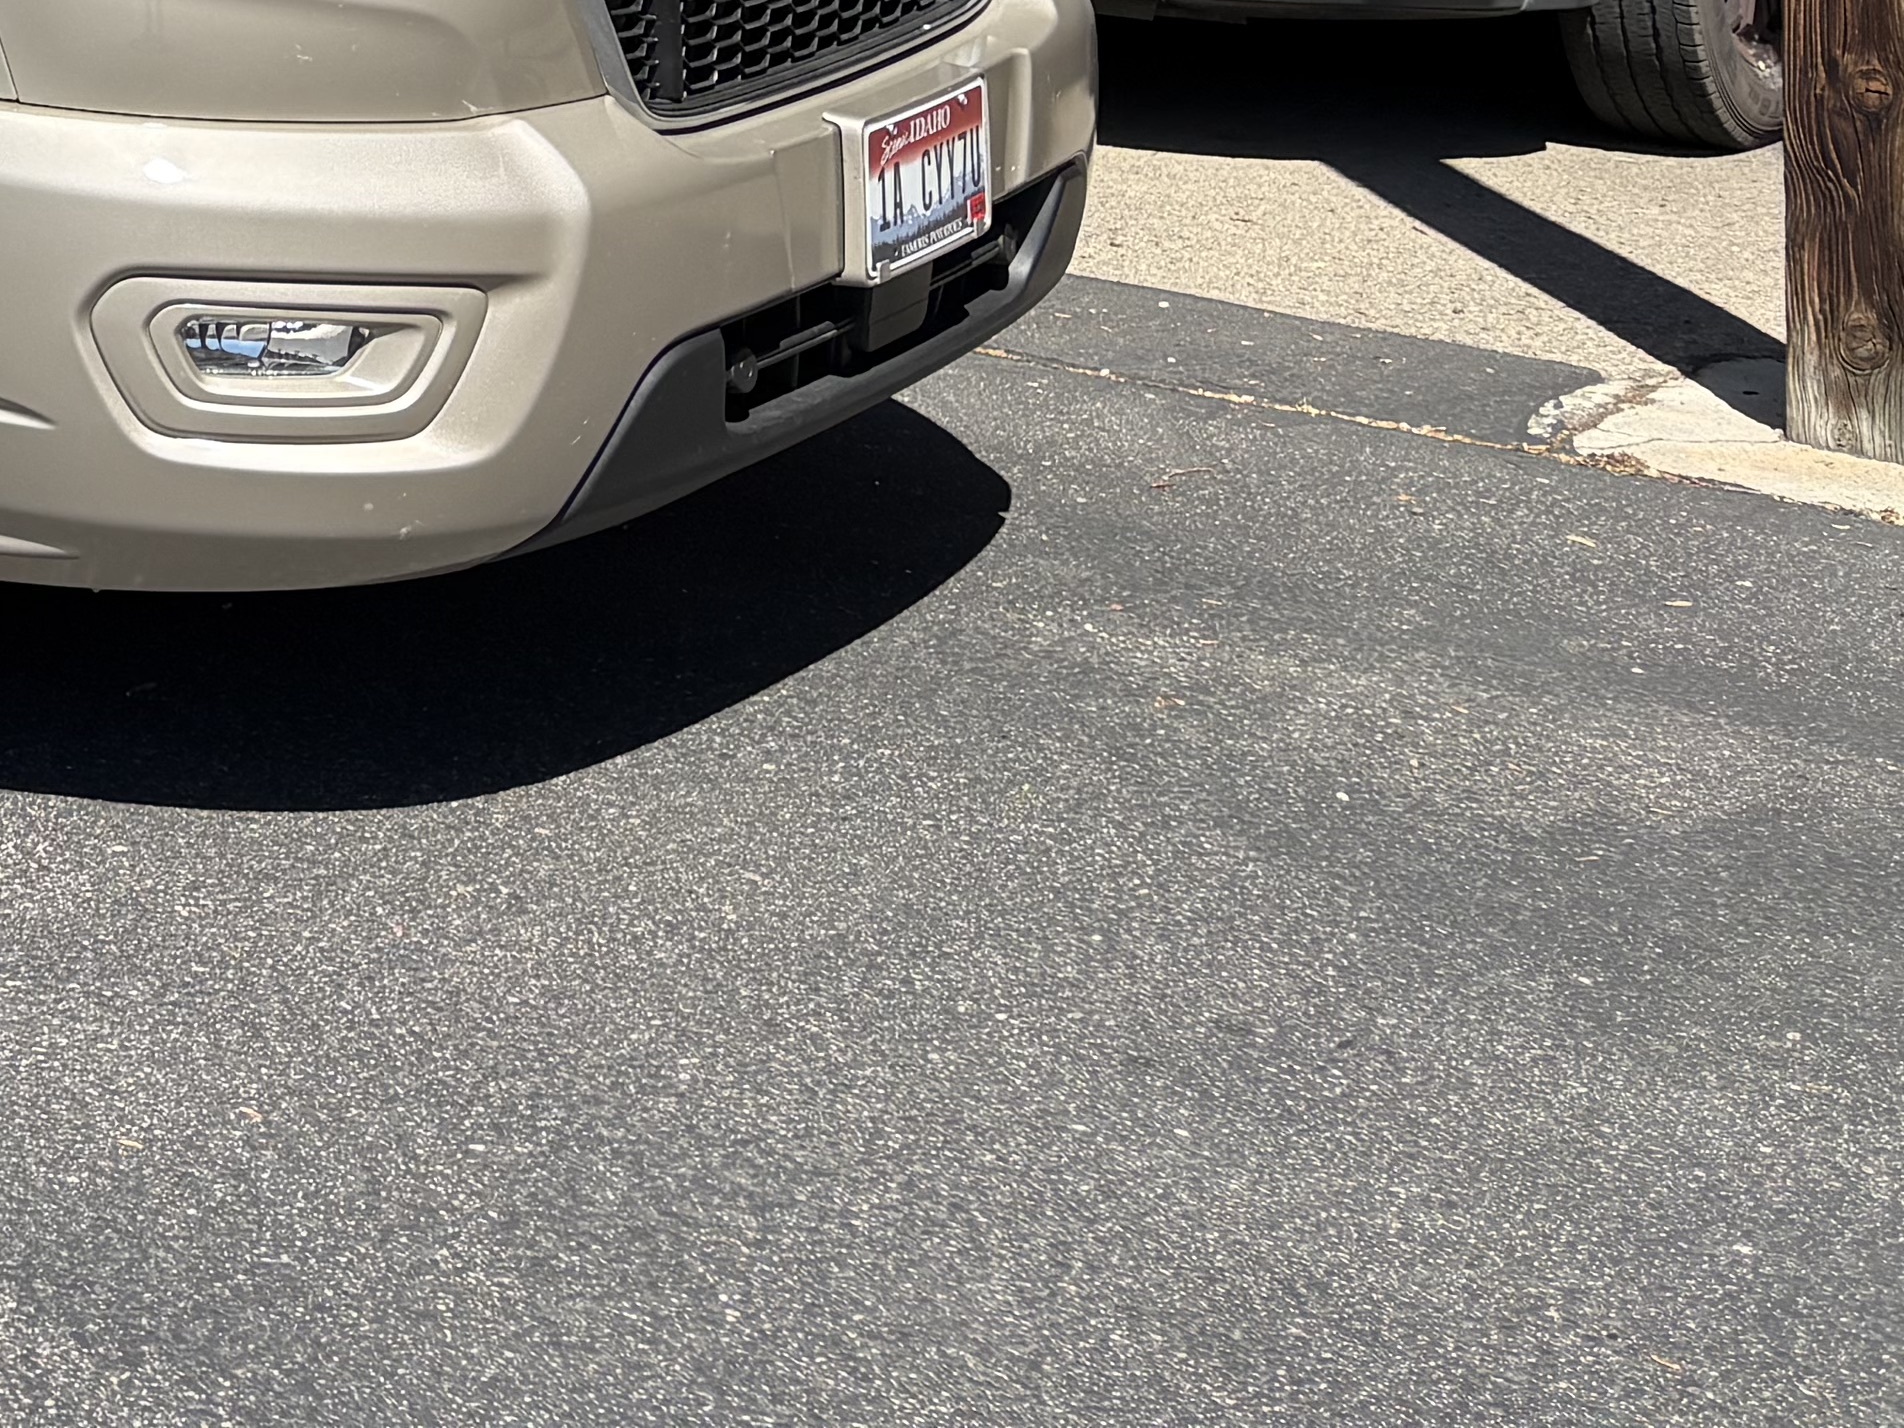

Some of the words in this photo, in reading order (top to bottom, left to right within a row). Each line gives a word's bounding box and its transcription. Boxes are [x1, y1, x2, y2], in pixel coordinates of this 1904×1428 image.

[910, 104, 951, 143] IDAHO
[878, 161, 905, 232] 1A
[921, 125, 982, 212] CYY7U
